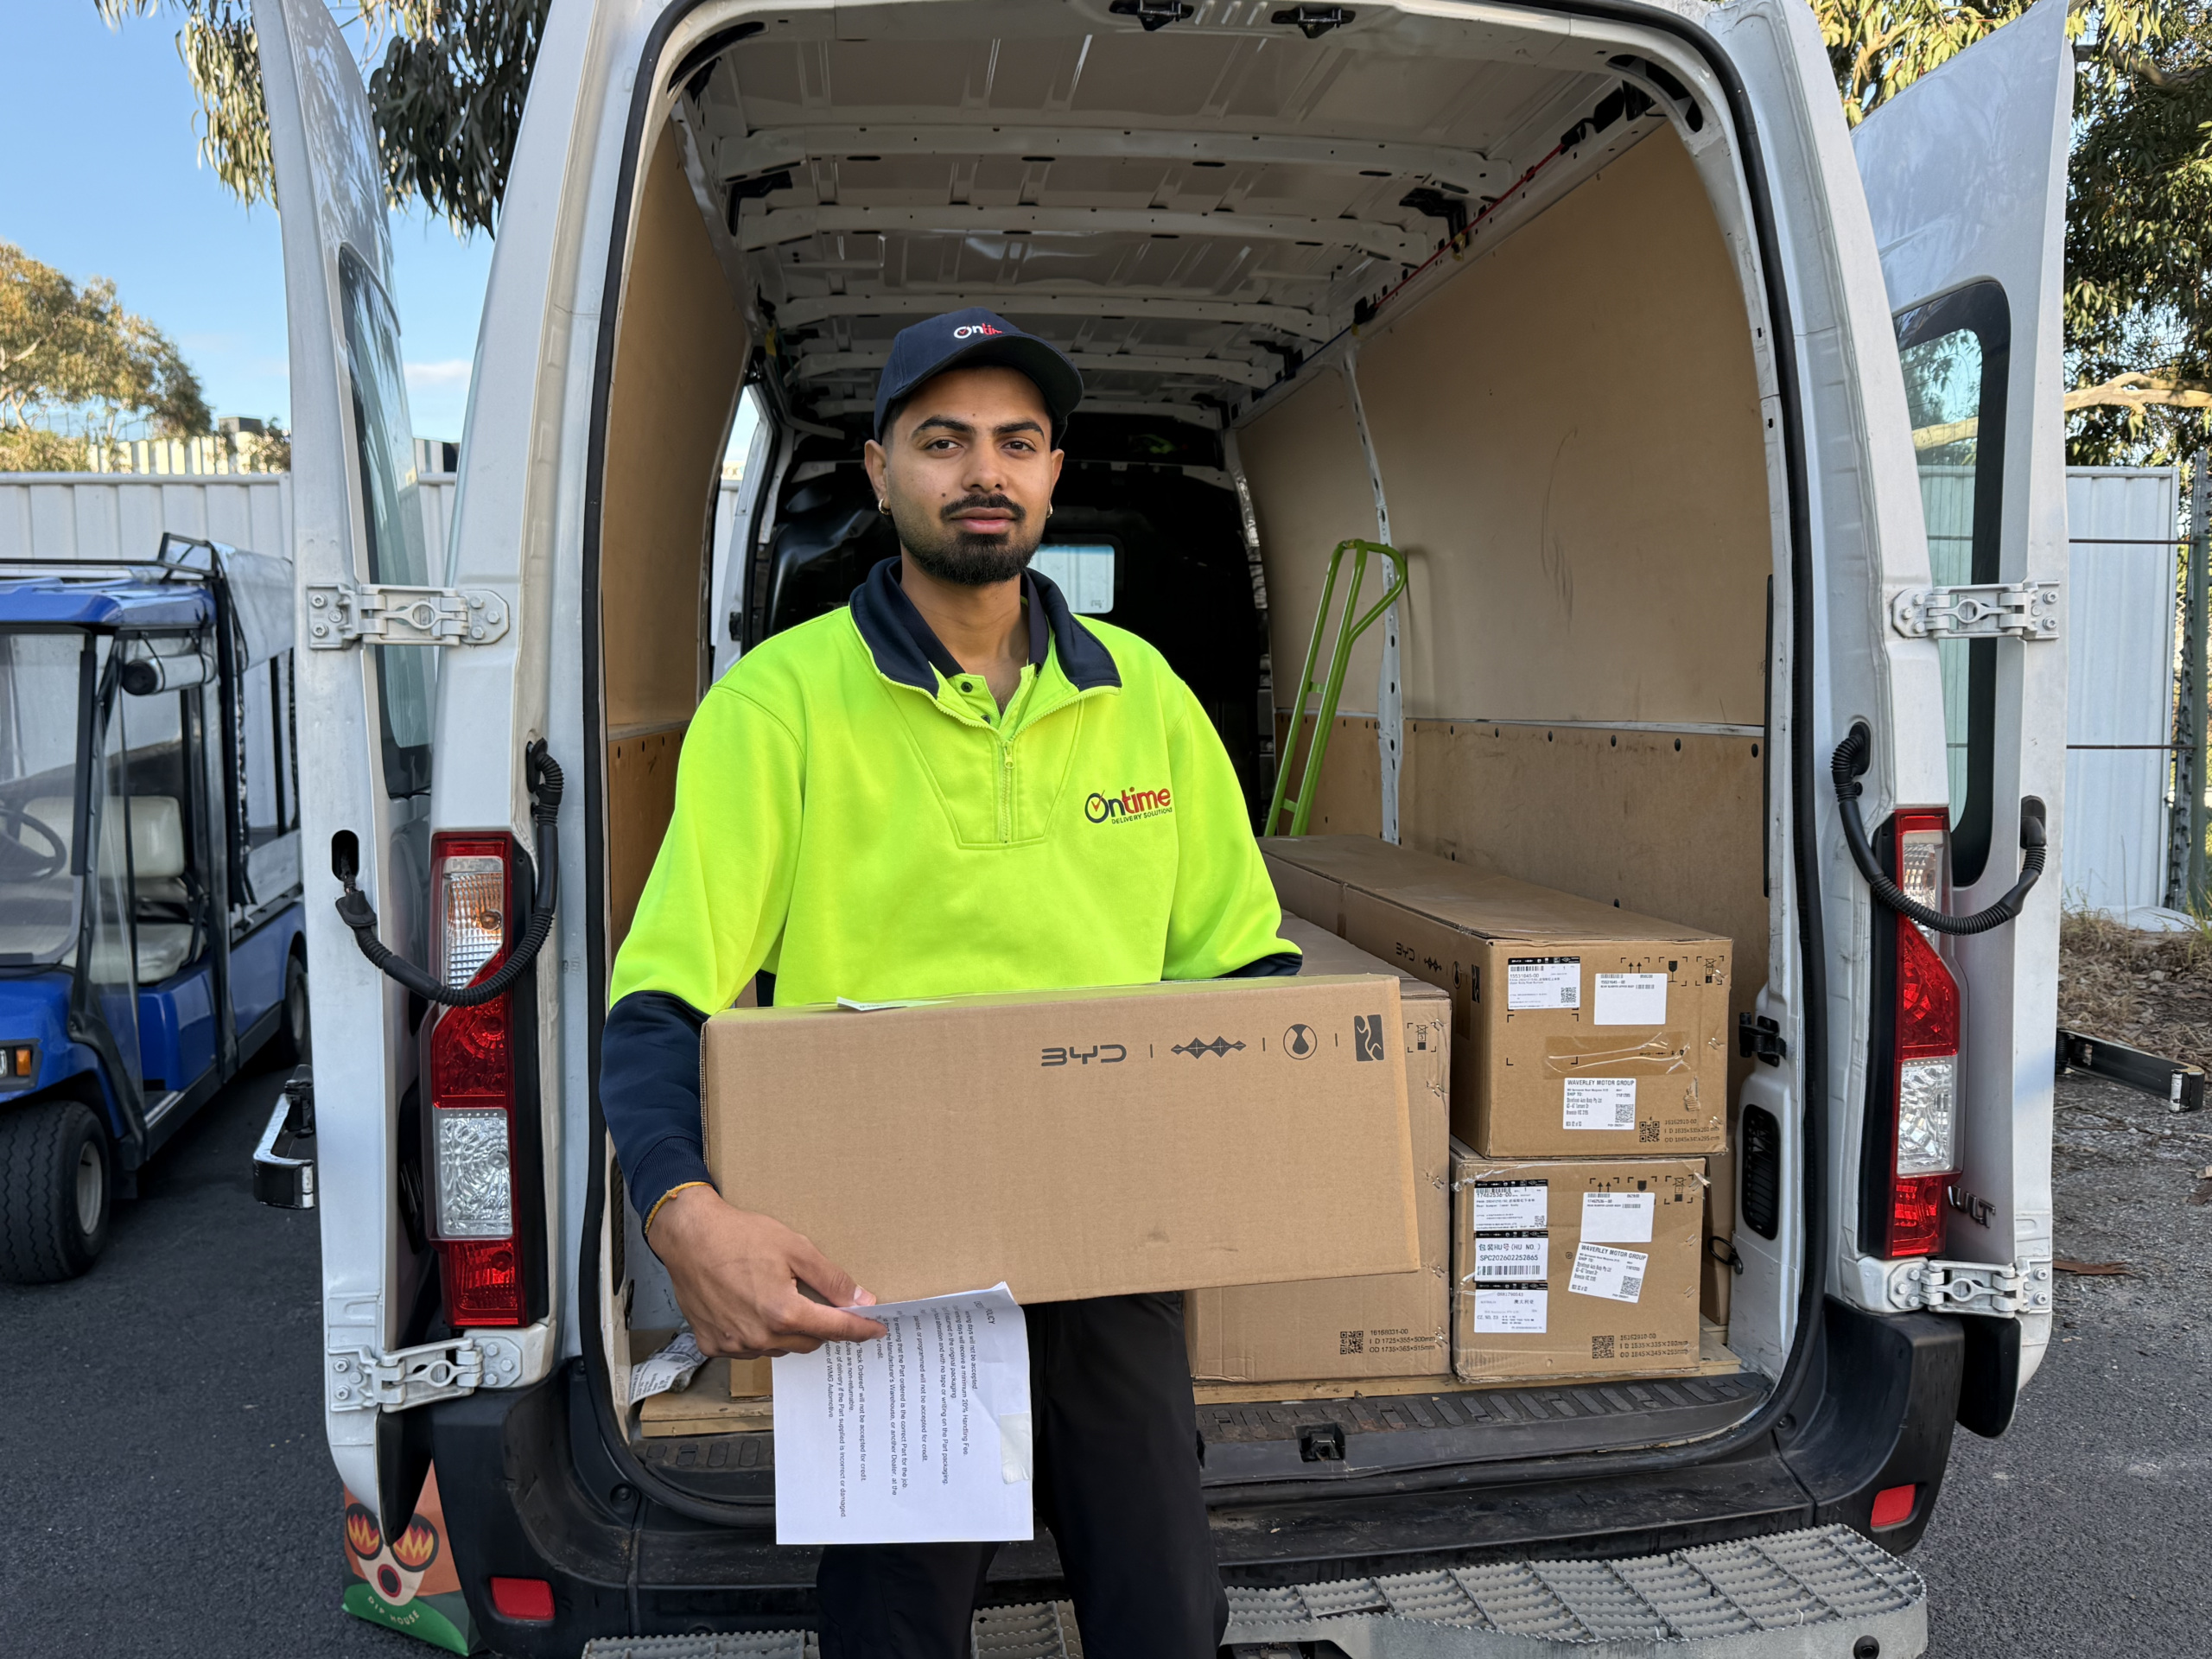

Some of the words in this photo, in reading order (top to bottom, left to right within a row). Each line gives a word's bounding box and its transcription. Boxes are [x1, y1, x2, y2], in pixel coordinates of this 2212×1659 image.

[1084, 786, 1172, 823] Ontime
[1111, 814, 1142, 824] DELIVERY
[1143, 807, 1173, 819] SOLUTIONS
[1396, 942, 1415, 961] BYD
[1041, 1044, 1127, 1067] BYD
[1948, 1185, 1996, 1230] ULT
[1580, 1244, 1609, 1255] WAVERLEY
[1629, 1252, 1647, 1261] GROUP
[917, 1338, 925, 1372] programmed
[390, 1610, 420, 1625] HOUSE
